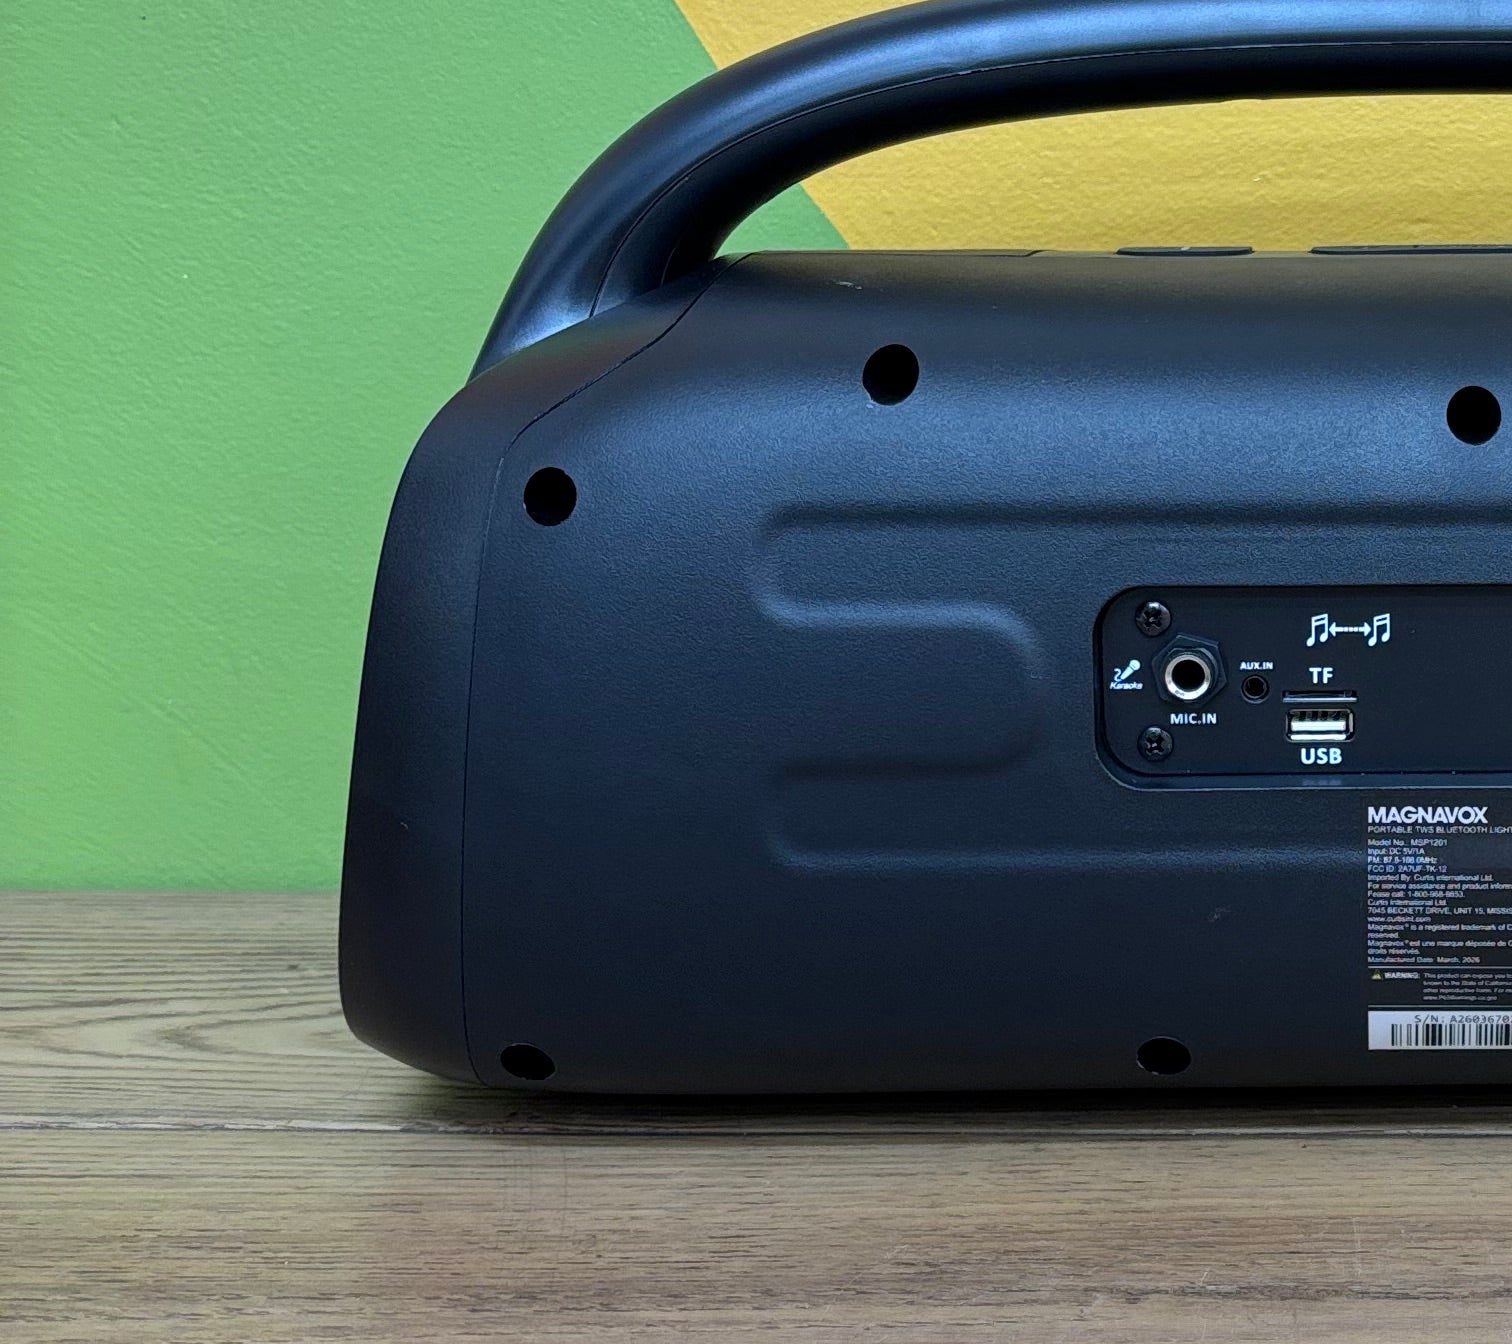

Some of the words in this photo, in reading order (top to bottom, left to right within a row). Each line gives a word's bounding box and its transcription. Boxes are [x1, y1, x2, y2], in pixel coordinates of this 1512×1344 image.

[1240, 661, 1273, 670] AUX.IN
[1309, 667, 1334, 684] TF
[1110, 681, 1143, 690] Karaoke
[1170, 712, 1217, 725] MIC.IN
[1300, 748, 1342, 765] USB
[1368, 806, 1488, 824] MAGNAVOX
[1368, 826, 1413, 834] PORTABLE
[1436, 826, 1487, 834] BLUETOOTH
[1414, 1014, 1445, 1024] S/N:
